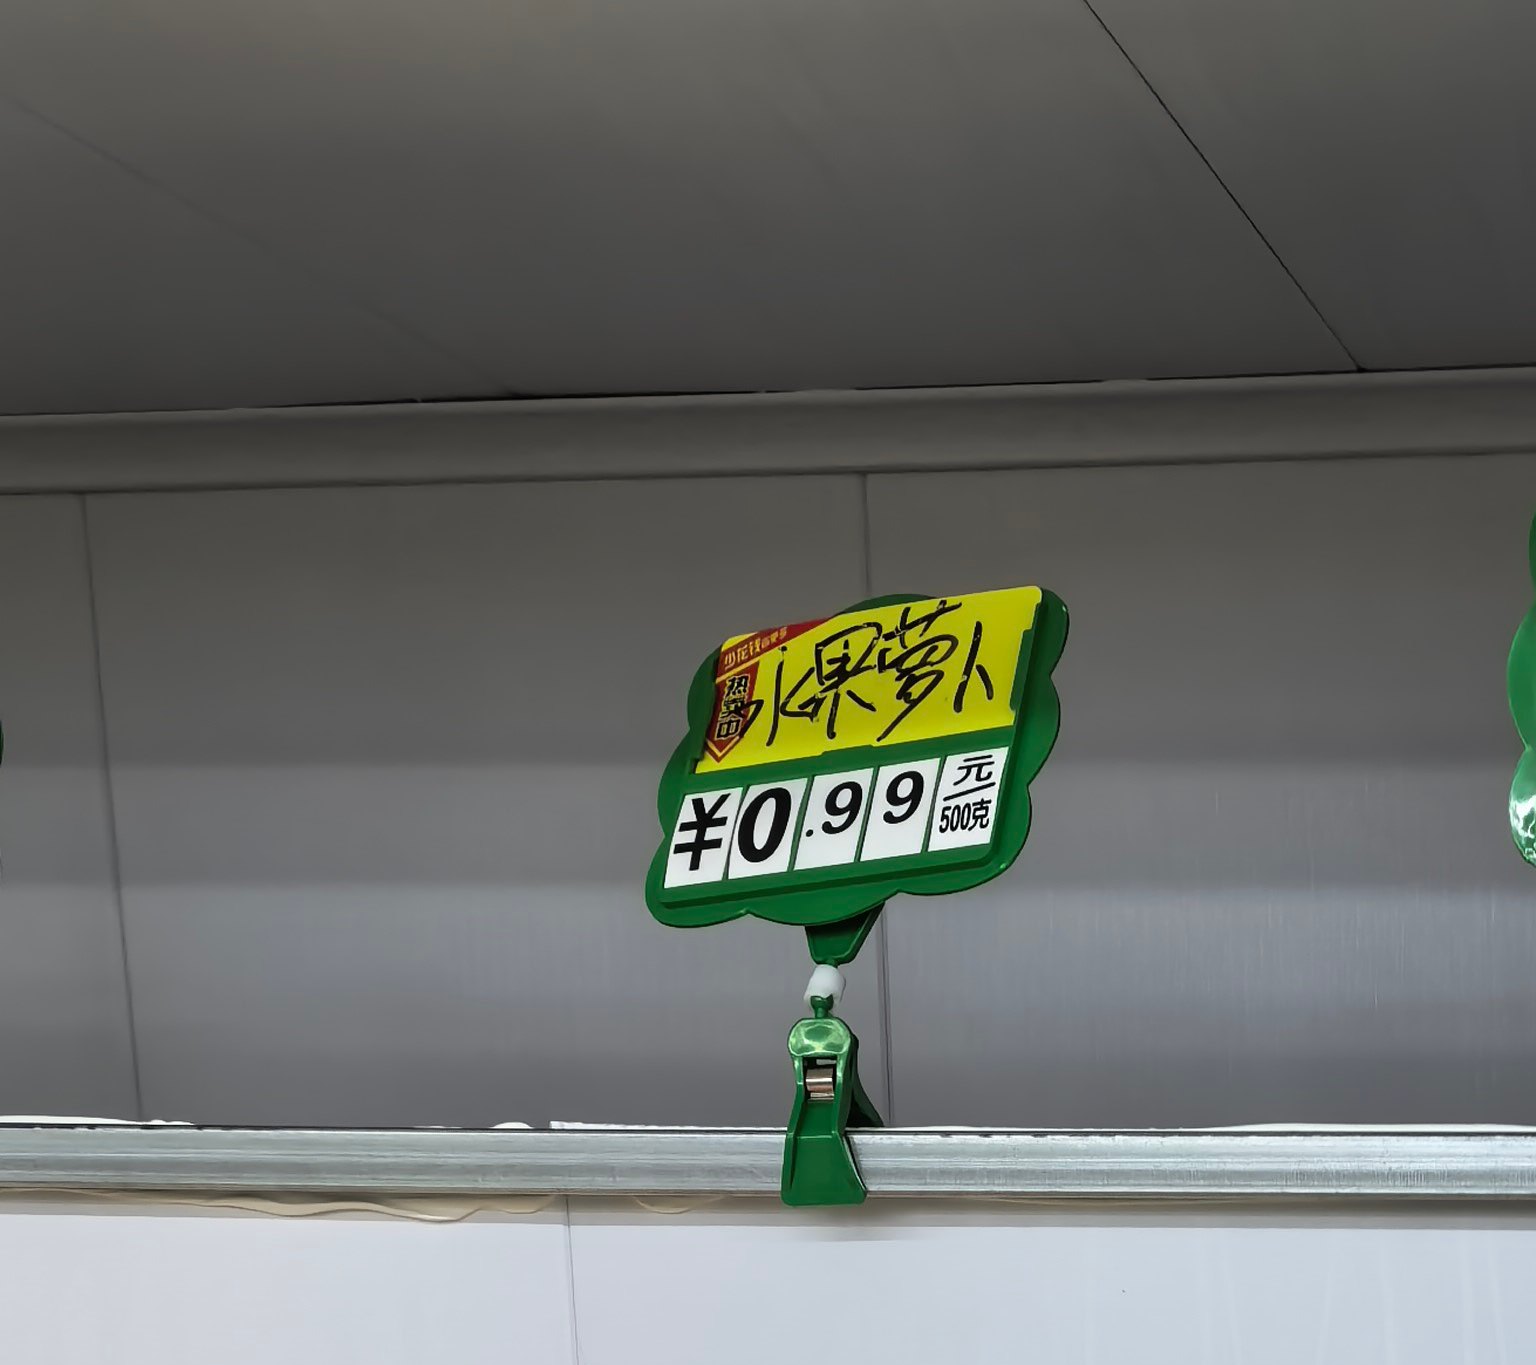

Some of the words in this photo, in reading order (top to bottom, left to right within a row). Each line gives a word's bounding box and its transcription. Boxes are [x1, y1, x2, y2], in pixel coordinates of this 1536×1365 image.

[739, 600, 994, 747] 水果萝卜
[952, 755, 995, 787] 元
[939, 799, 992, 835] 500克
